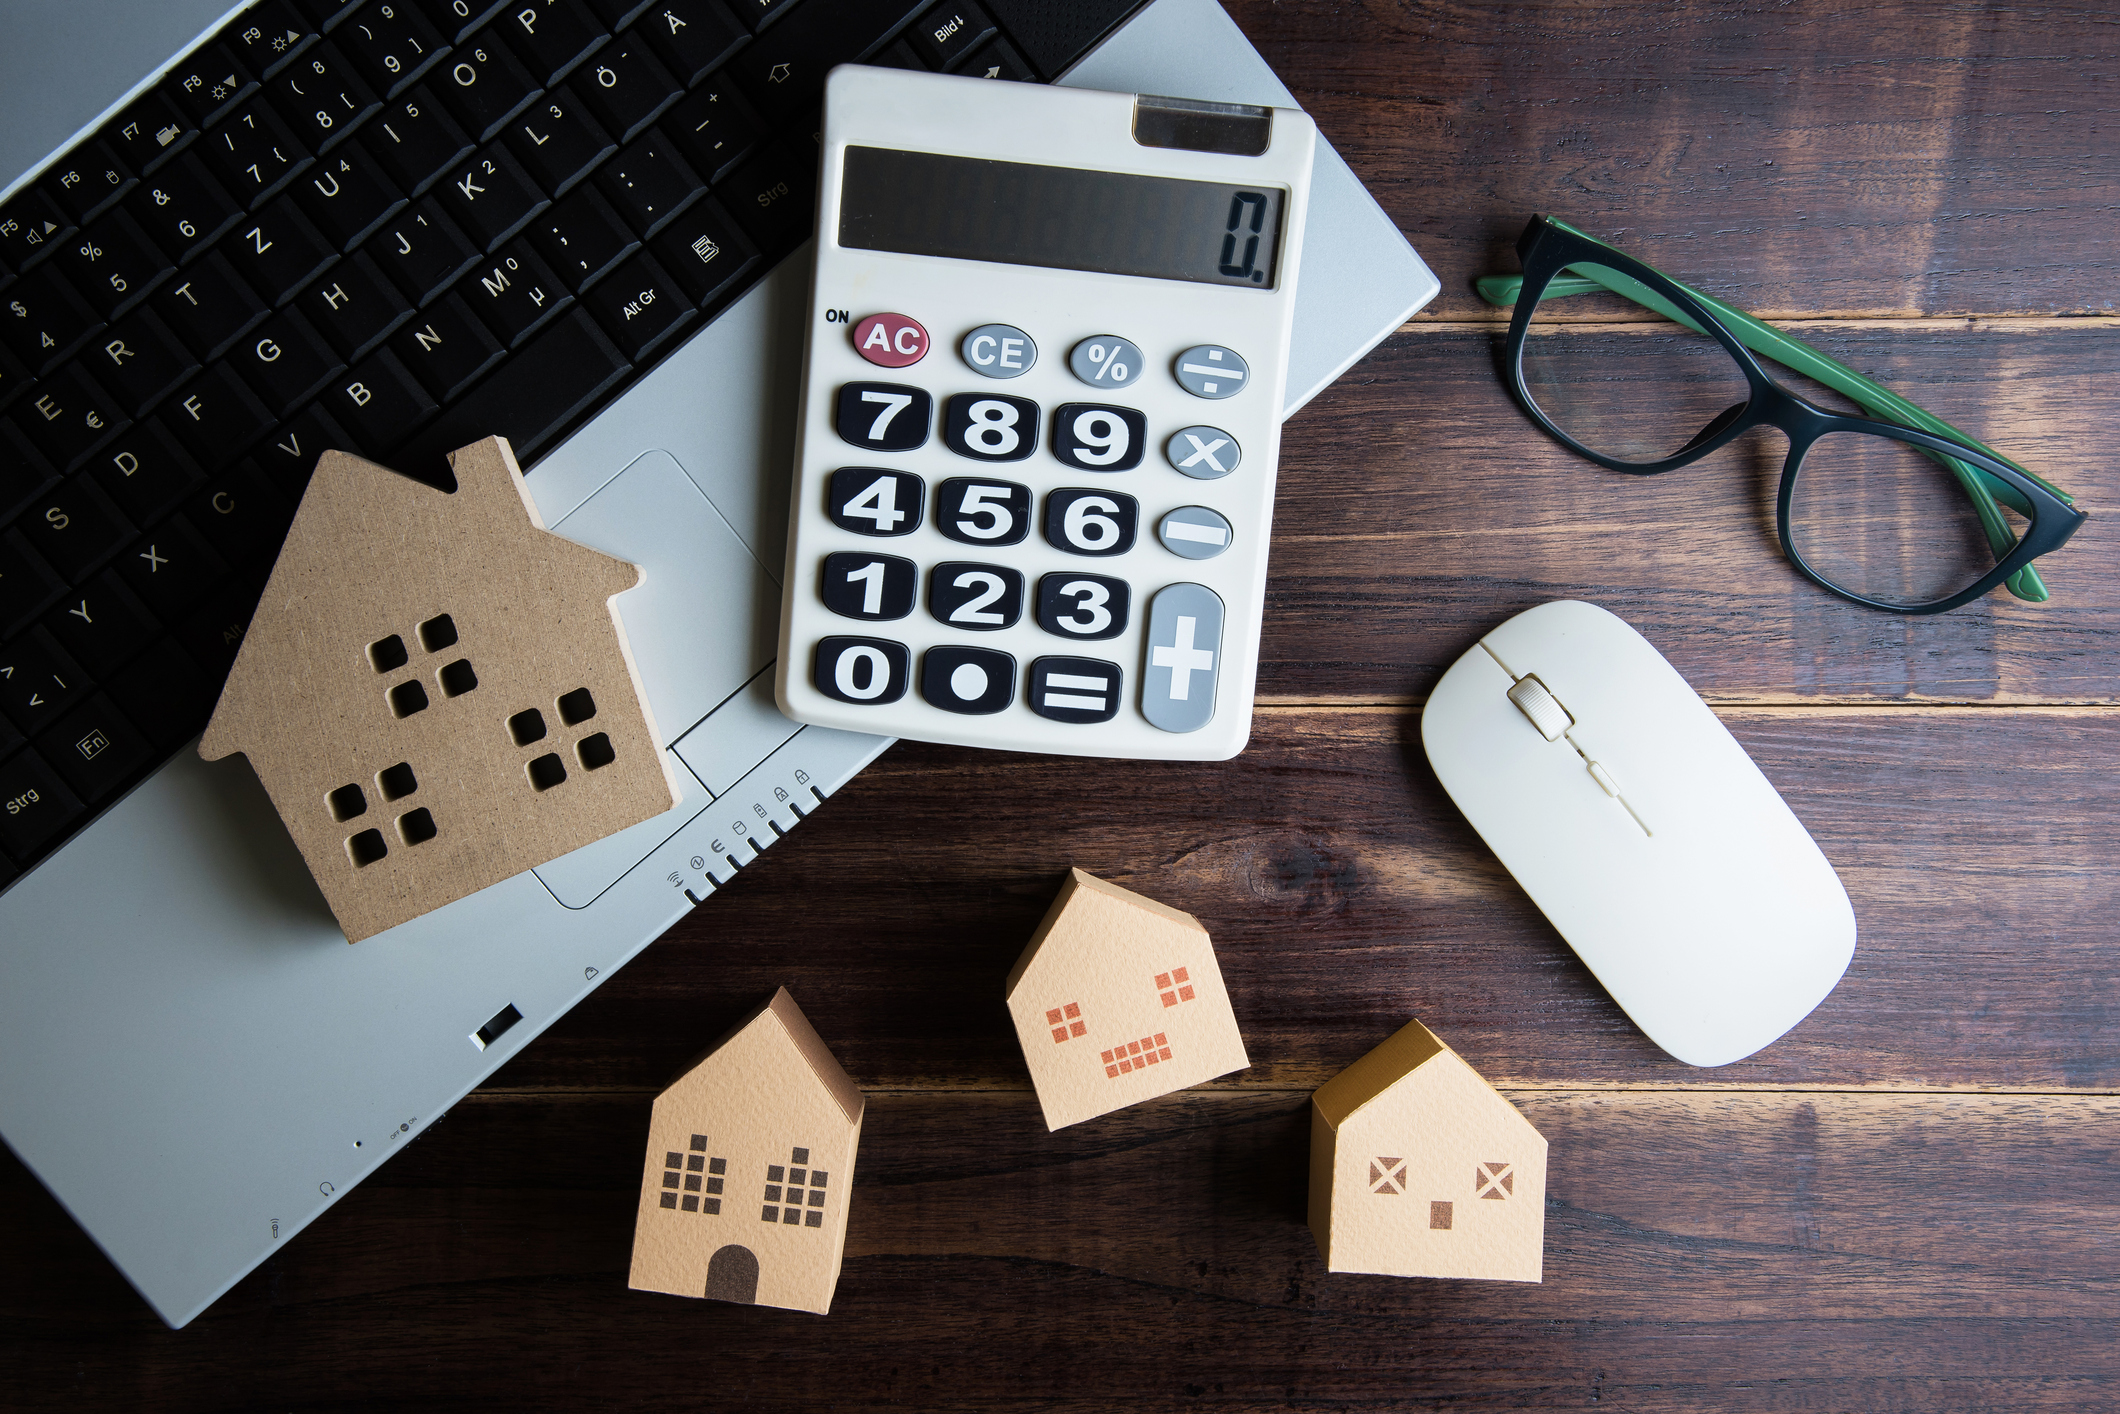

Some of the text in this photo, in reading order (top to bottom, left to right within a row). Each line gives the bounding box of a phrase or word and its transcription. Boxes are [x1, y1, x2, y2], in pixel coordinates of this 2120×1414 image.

[381, 5, 394, 18] 9
[453, 0, 469, 16] 0
[517, 8, 537, 34] P
[663, 10, 687, 34] Ä
[934, 21, 958, 43] Bild
[242, 27, 261, 44] F9
[384, 55, 401, 72] 9
[475, 48, 487, 61] 6
[312, 61, 325, 73] 8
[453, 63, 476, 86] O
[596, 65, 617, 87] Ö
[182, 74, 202, 92] F8
[243, 114, 255, 128] 7
[316, 110, 333, 127] 8
[406, 103, 419, 117] 5
[549, 105, 563, 118] 3
[121, 121, 140, 140] F7
[524, 126, 550, 145] L
[246, 163, 262, 182] 7
[340, 159, 351, 171] 4
[482, 160, 496, 174] 2
[60, 171, 81, 188] F6
[314, 171, 339, 197] U
[457, 172, 486, 200] K
[152, 189, 171, 205] &
[758, 182, 788, 206] Strg
[0, 218, 19, 236] F5
[179, 220, 196, 237] 6
[417, 214, 428, 225] 1
[80, 241, 103, 261] %
[245, 226, 273, 254] Z
[395, 231, 411, 254] J
[506, 257, 518, 270] 0
[109, 273, 127, 291] 5
[174, 282, 198, 305] T
[481, 268, 511, 297] M
[322, 282, 349, 309] H
[623, 288, 657, 320] Alt Gr
[10, 301, 27, 317] $
[826, 309, 849, 323] ON
[41, 331, 55, 347] 4
[414, 324, 442, 351] N
[862, 323, 920, 354] AC
[105, 339, 135, 365] R
[256, 338, 282, 361] G
[970, 335, 1025, 369] CE
[346, 382, 372, 406] B
[34, 394, 63, 420] E
[183, 394, 202, 420] F
[862, 391, 912, 440] 7
[86, 410, 104, 428] €
[963, 400, 1020, 455] 8
[277, 432, 301, 456] V
[1072, 410, 1130, 465] 9
[113, 451, 139, 476] D
[212, 491, 235, 513] C
[843, 476, 905, 531] 4
[956, 485, 1012, 539] 5
[45, 507, 69, 529] S
[1063, 496, 1120, 551] 6
[139, 544, 169, 572] X
[847, 562, 885, 614] 1
[949, 571, 1007, 625] 2
[69, 599, 93, 623] Y
[1056, 580, 1112, 634] 3
[222, 624, 245, 645] Alt
[834, 645, 891, 699] 0
[81, 734, 105, 755] Fn
[7, 789, 39, 814] Strg
